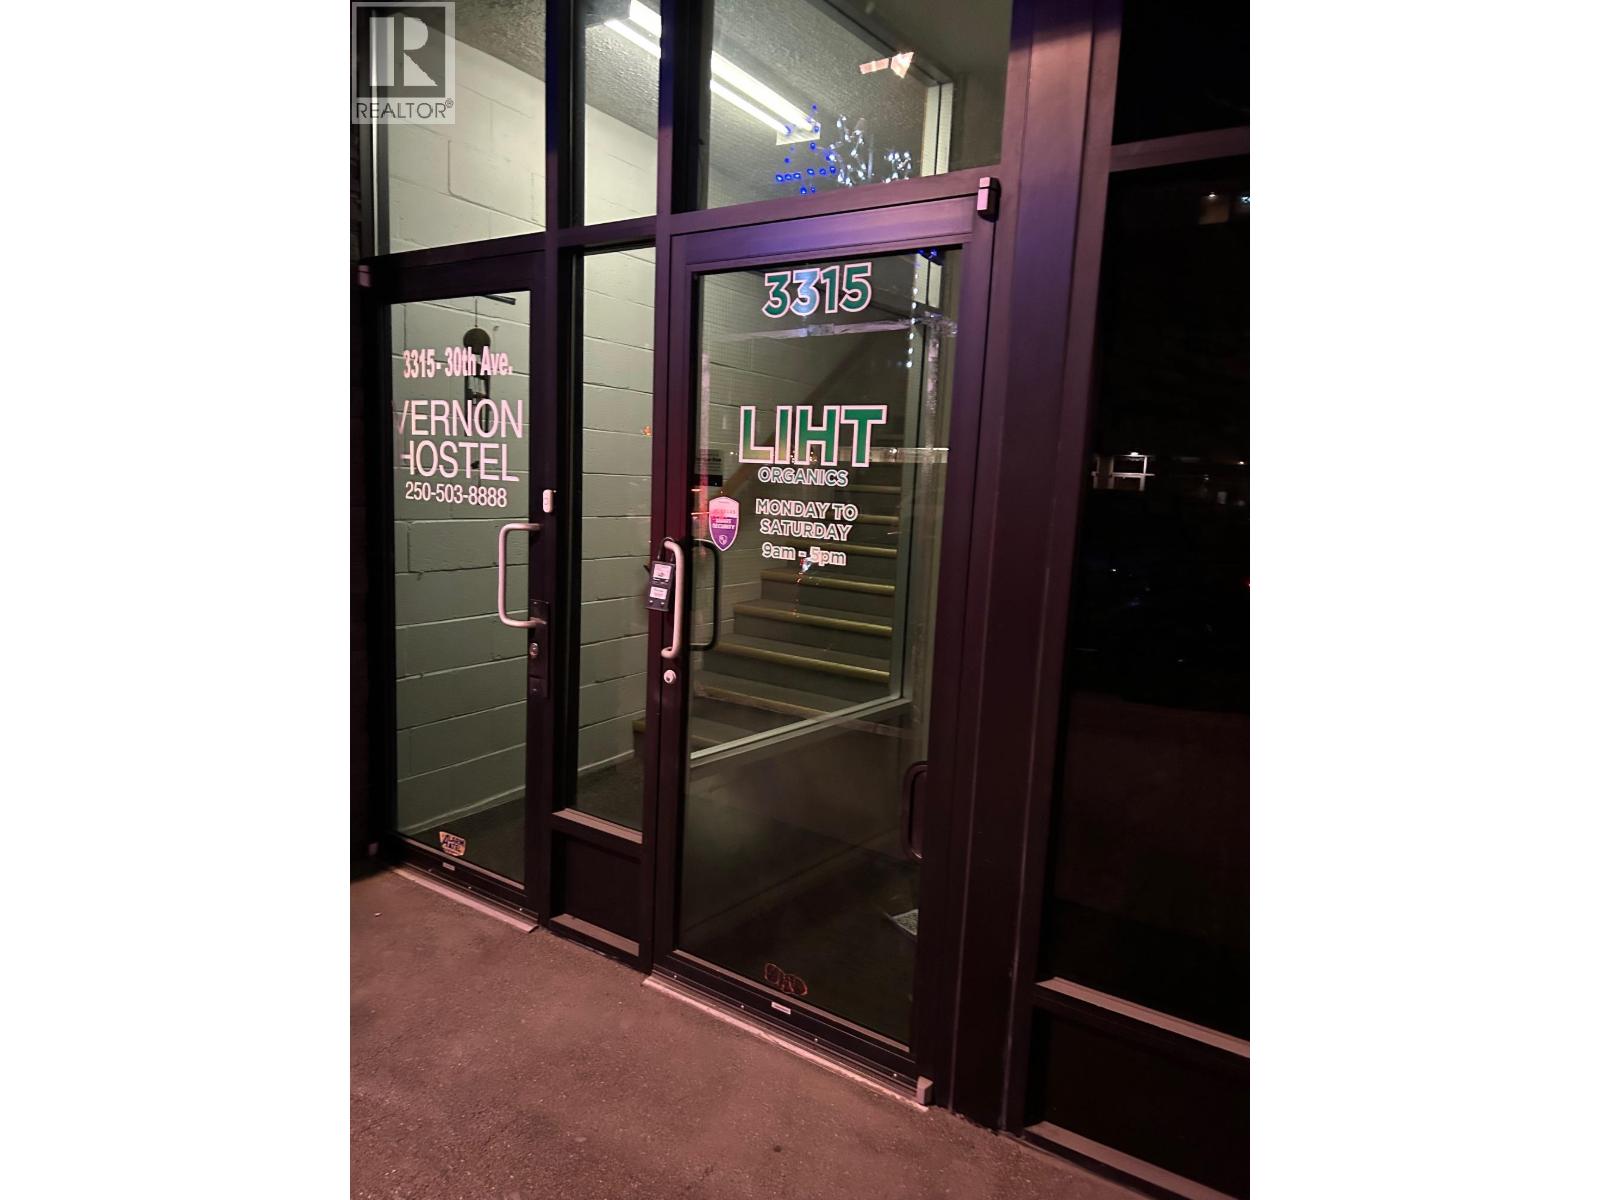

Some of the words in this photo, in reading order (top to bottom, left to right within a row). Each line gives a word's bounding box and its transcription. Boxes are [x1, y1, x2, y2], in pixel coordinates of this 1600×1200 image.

[761, 262, 873, 318] 3315
[444, 346, 476, 377] 30th
[480, 345, 513, 376] Ave.
[738, 404, 888, 468] LIHT
[400, 439, 520, 482] HOSTEL
[757, 466, 849, 487] ORGANICS
[405, 481, 507, 508] 250-503-8888
[755, 498, 831, 519] MONDAY
[832, 504, 858, 522] TO
[759, 518, 852, 542] SATURDAY
[761, 542, 796, 561] 9am
[809, 546, 847, 567] 5pm
